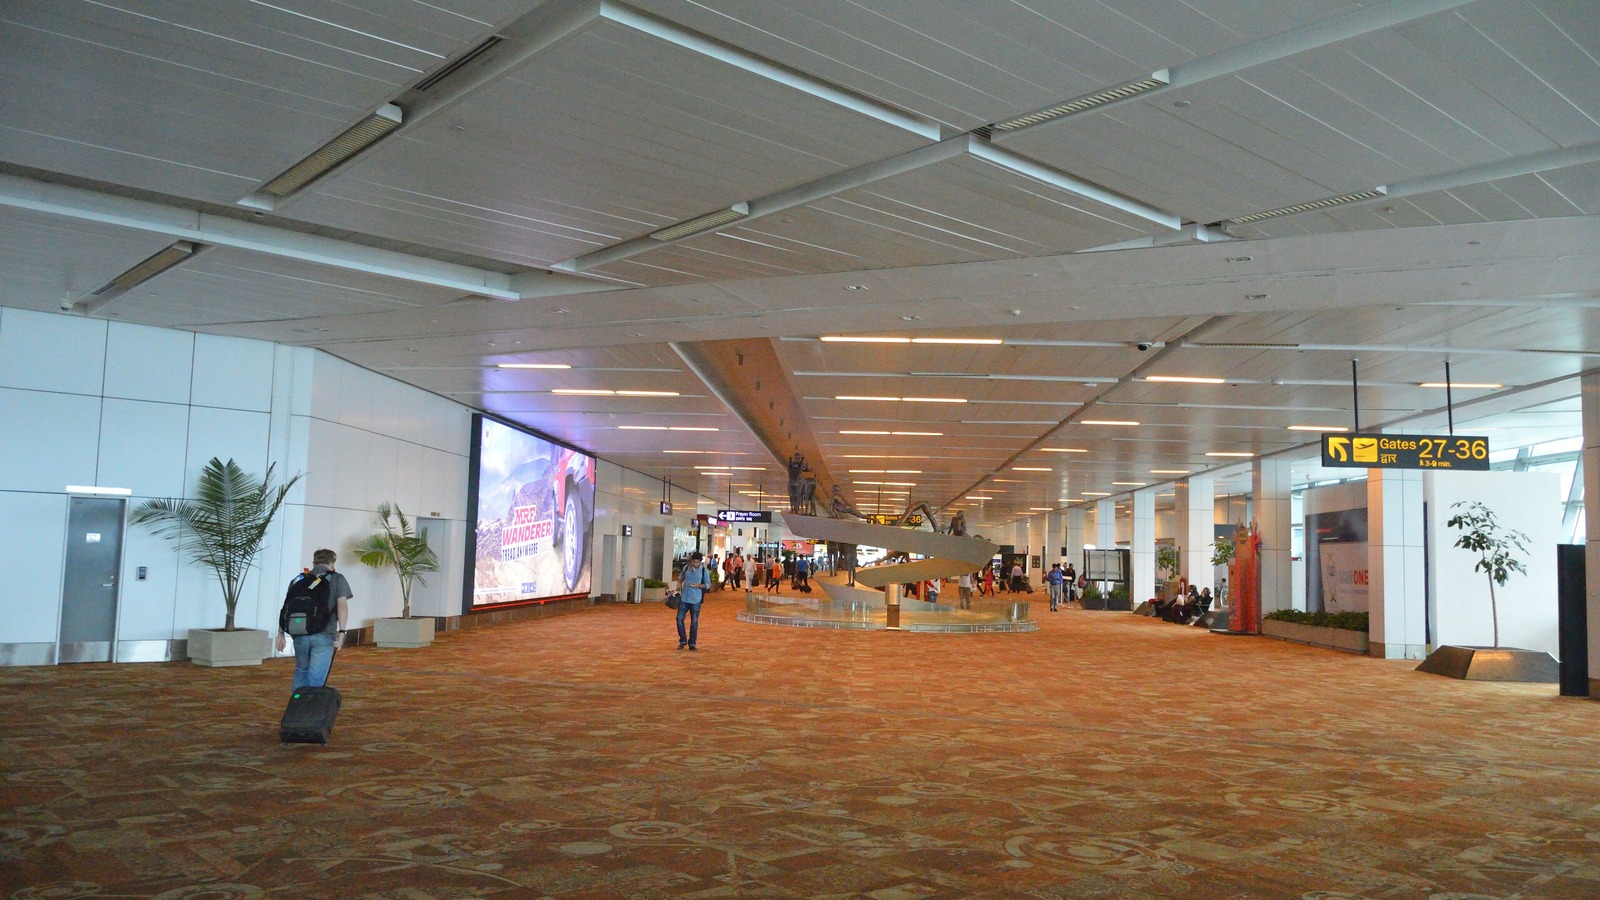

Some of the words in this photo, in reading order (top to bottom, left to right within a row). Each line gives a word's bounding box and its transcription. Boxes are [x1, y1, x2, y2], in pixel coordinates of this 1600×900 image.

[1380, 438, 1417, 450] Gates
[1418, 439, 1487, 460] 27-36
[1380, 453, 1397, 464] द्वार
[514, 507, 536, 526] MRF
[502, 521, 552, 546] WANDERER
